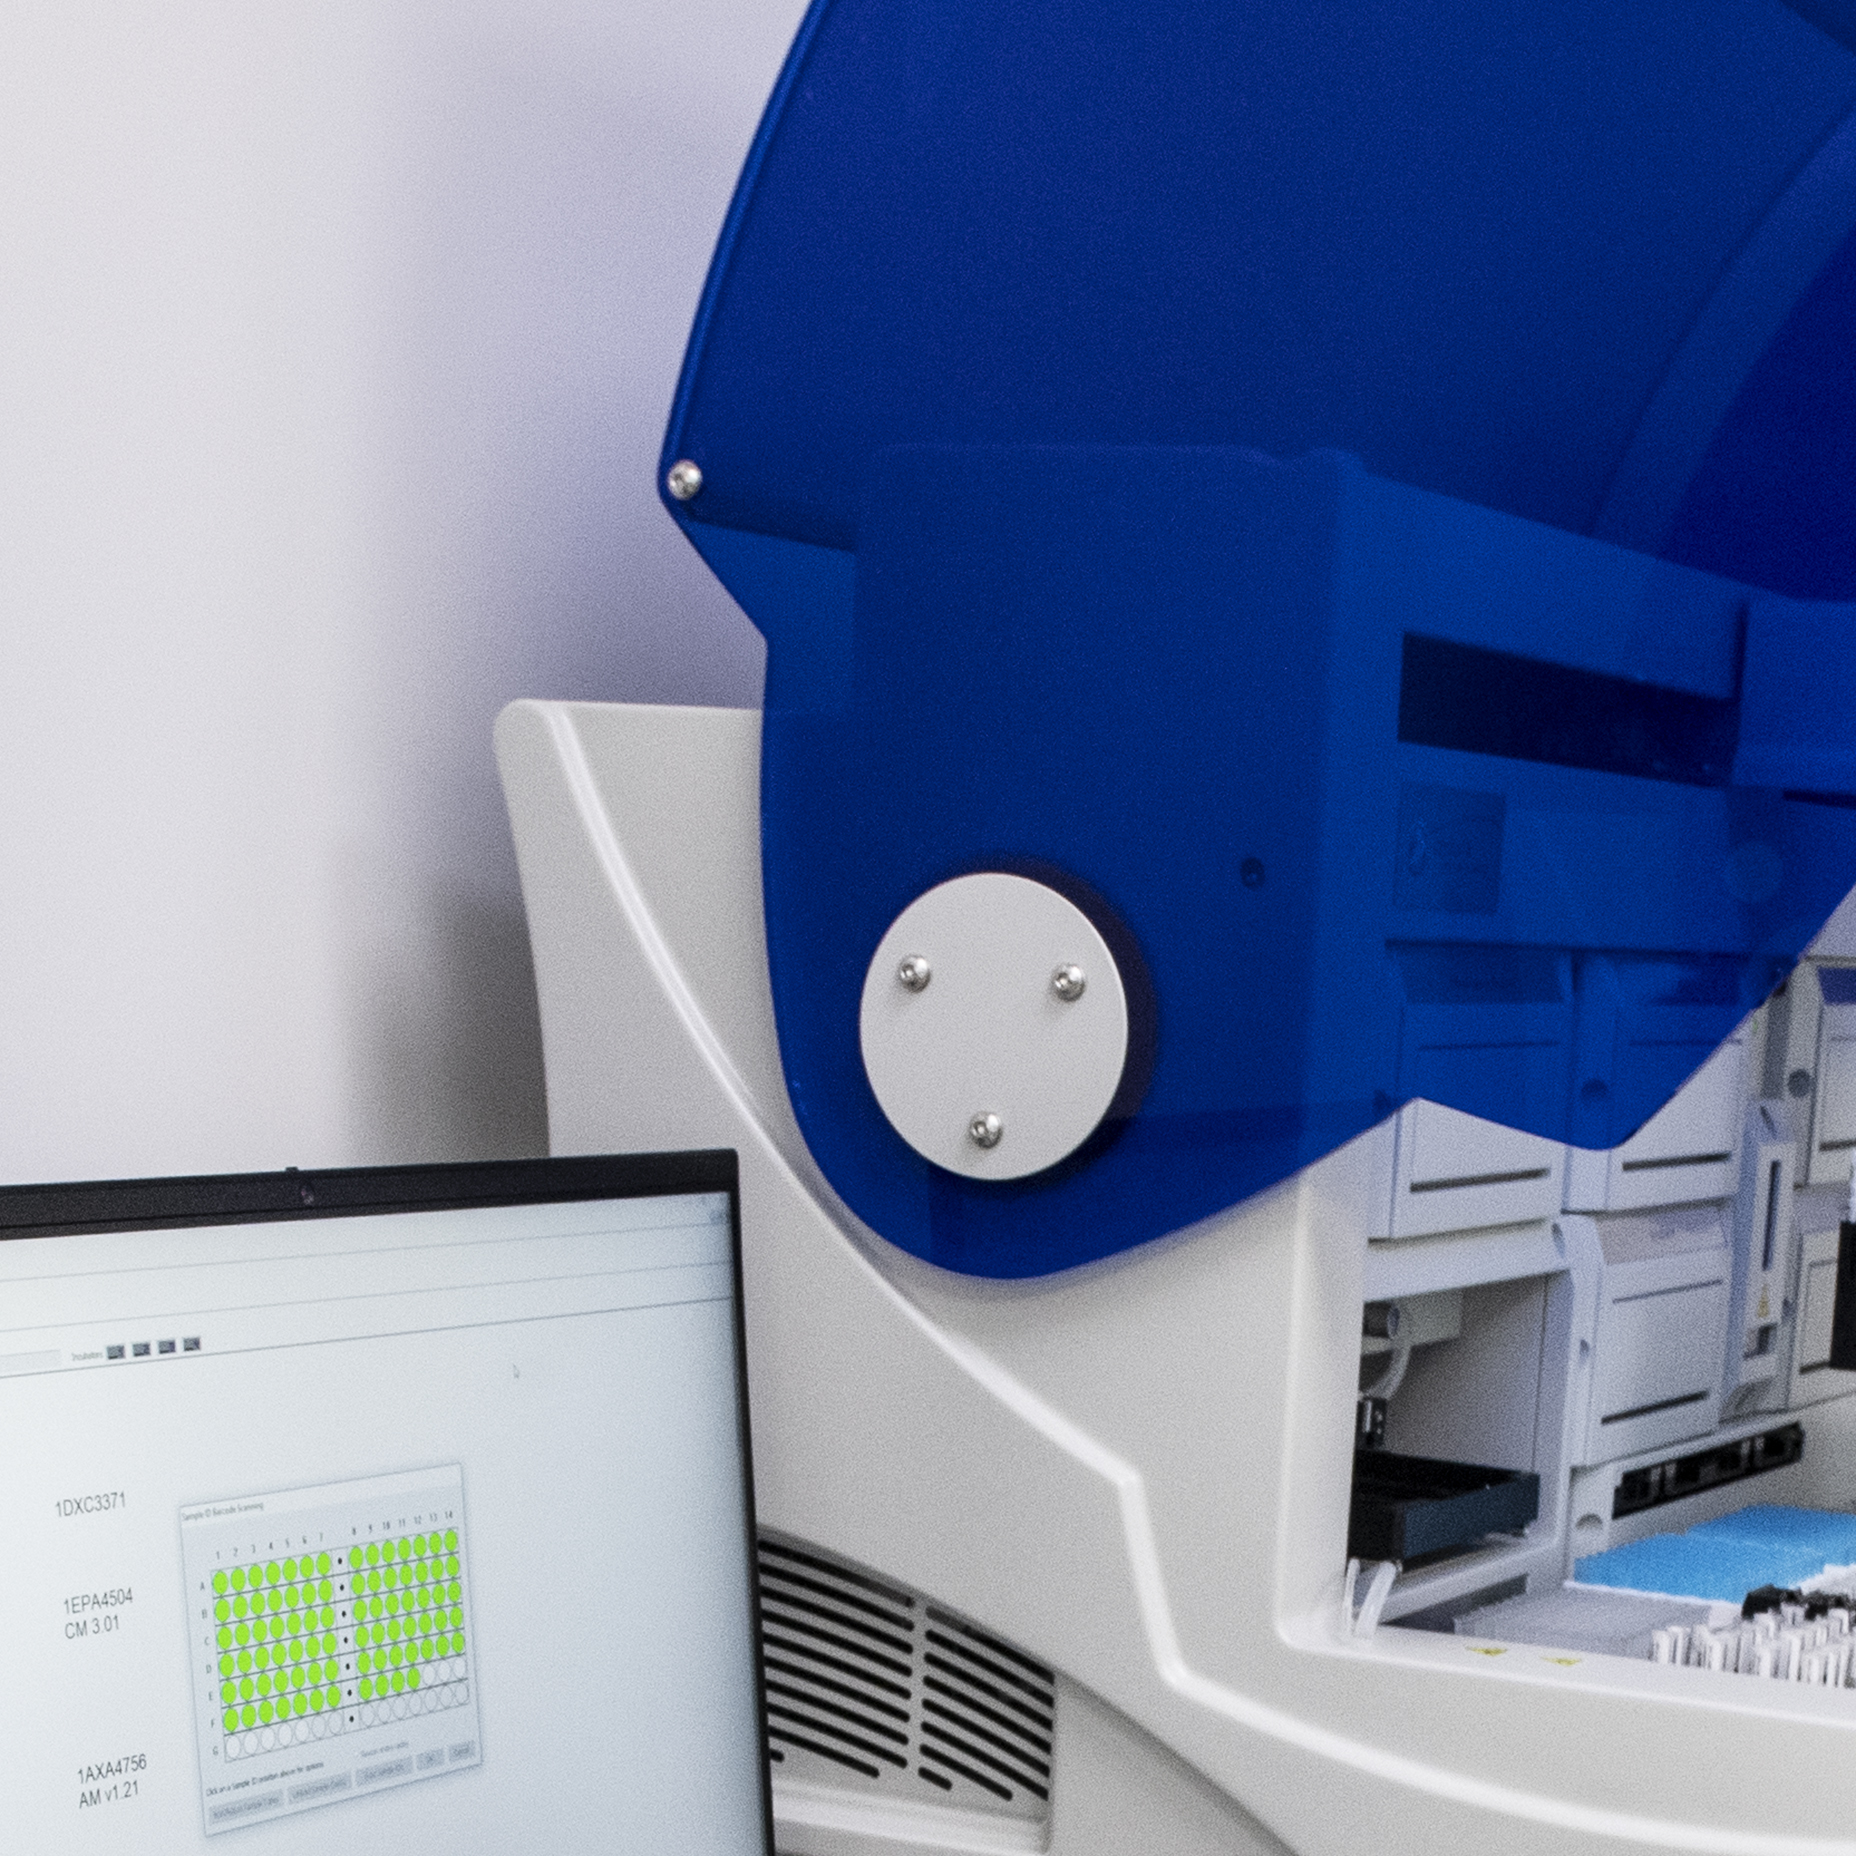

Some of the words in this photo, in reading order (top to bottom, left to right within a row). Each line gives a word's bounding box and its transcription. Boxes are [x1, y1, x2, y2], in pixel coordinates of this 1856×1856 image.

[56, 1490, 125, 1517] 1DXC3371
[63, 1587, 133, 1616] 1EPA4504
[65, 1620, 88, 1640] CM
[92, 1615, 120, 1635] 3.01
[77, 1753, 148, 1784] 1AXA4756
[79, 1789, 101, 1809] AM
[104, 1780, 139, 1804] v1.21
